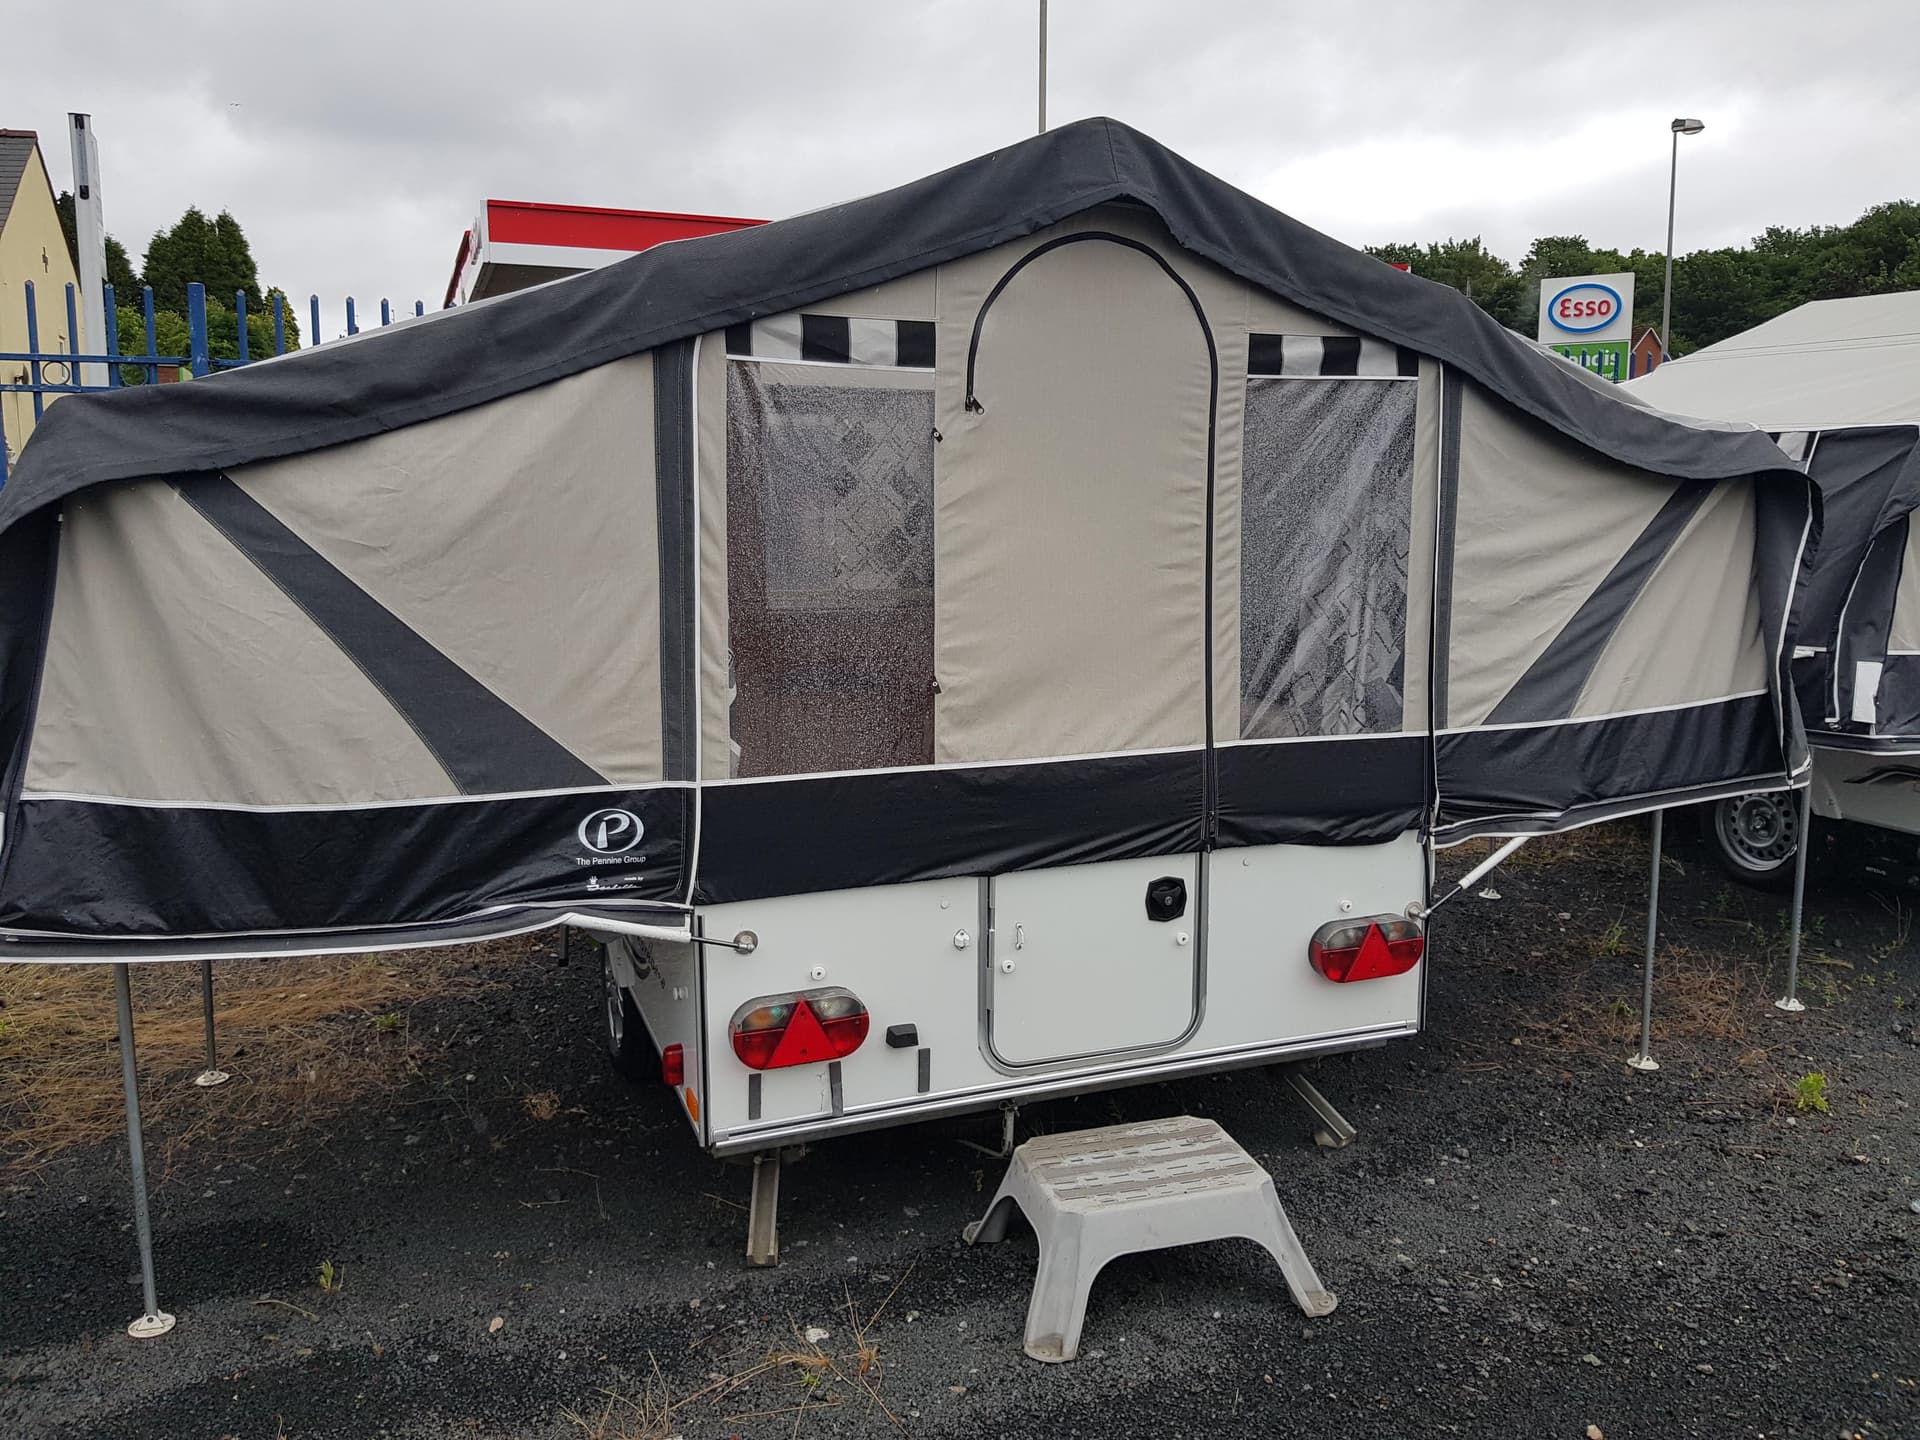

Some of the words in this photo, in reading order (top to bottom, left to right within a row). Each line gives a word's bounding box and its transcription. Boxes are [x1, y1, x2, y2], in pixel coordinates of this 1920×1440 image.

[1559, 298, 1611, 318] Esso
[576, 857, 591, 866] The
[592, 856, 622, 865] Pennine
[623, 855, 647, 864] Group
